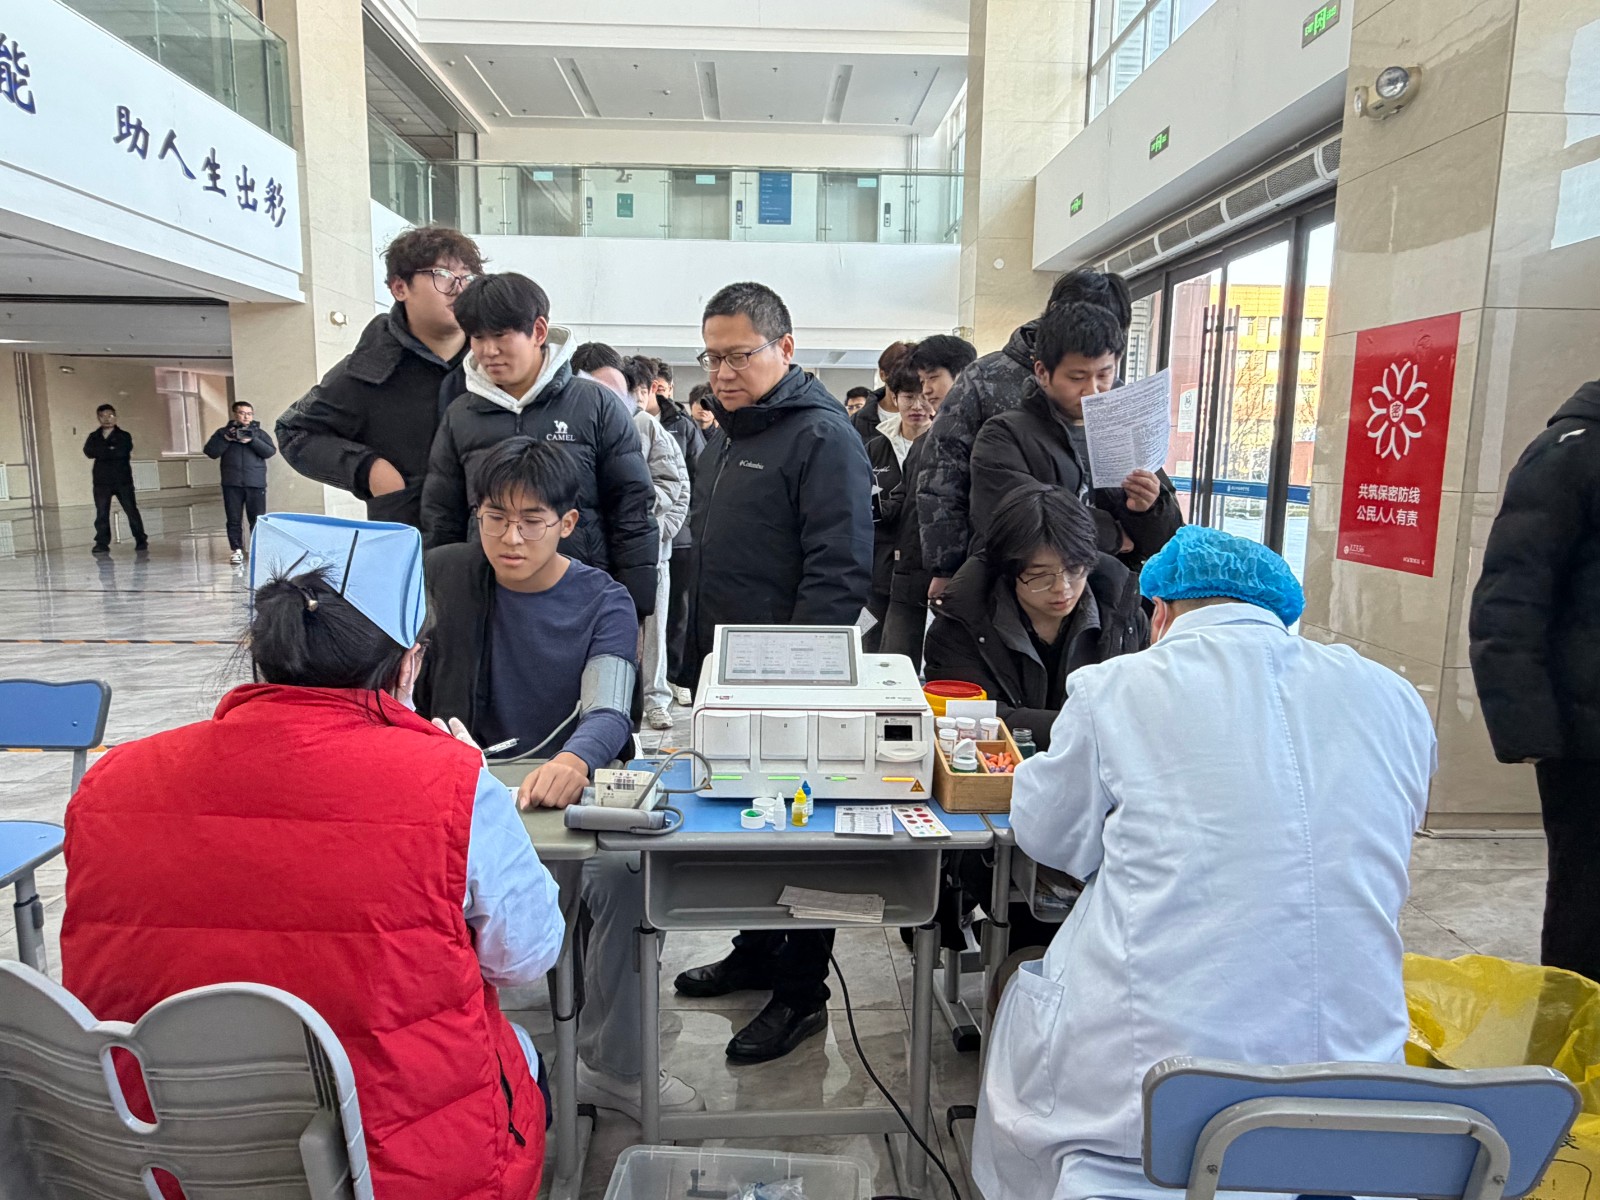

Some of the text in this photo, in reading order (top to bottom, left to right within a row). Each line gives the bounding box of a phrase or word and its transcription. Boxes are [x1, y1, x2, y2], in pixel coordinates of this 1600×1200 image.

[112, 104, 287, 228] 助人生出彩
[546, 433, 576, 442] CAMEL
[1357, 483, 1421, 504] 共筑保密防线
[1356, 505, 1419, 527] 公民人人有责
